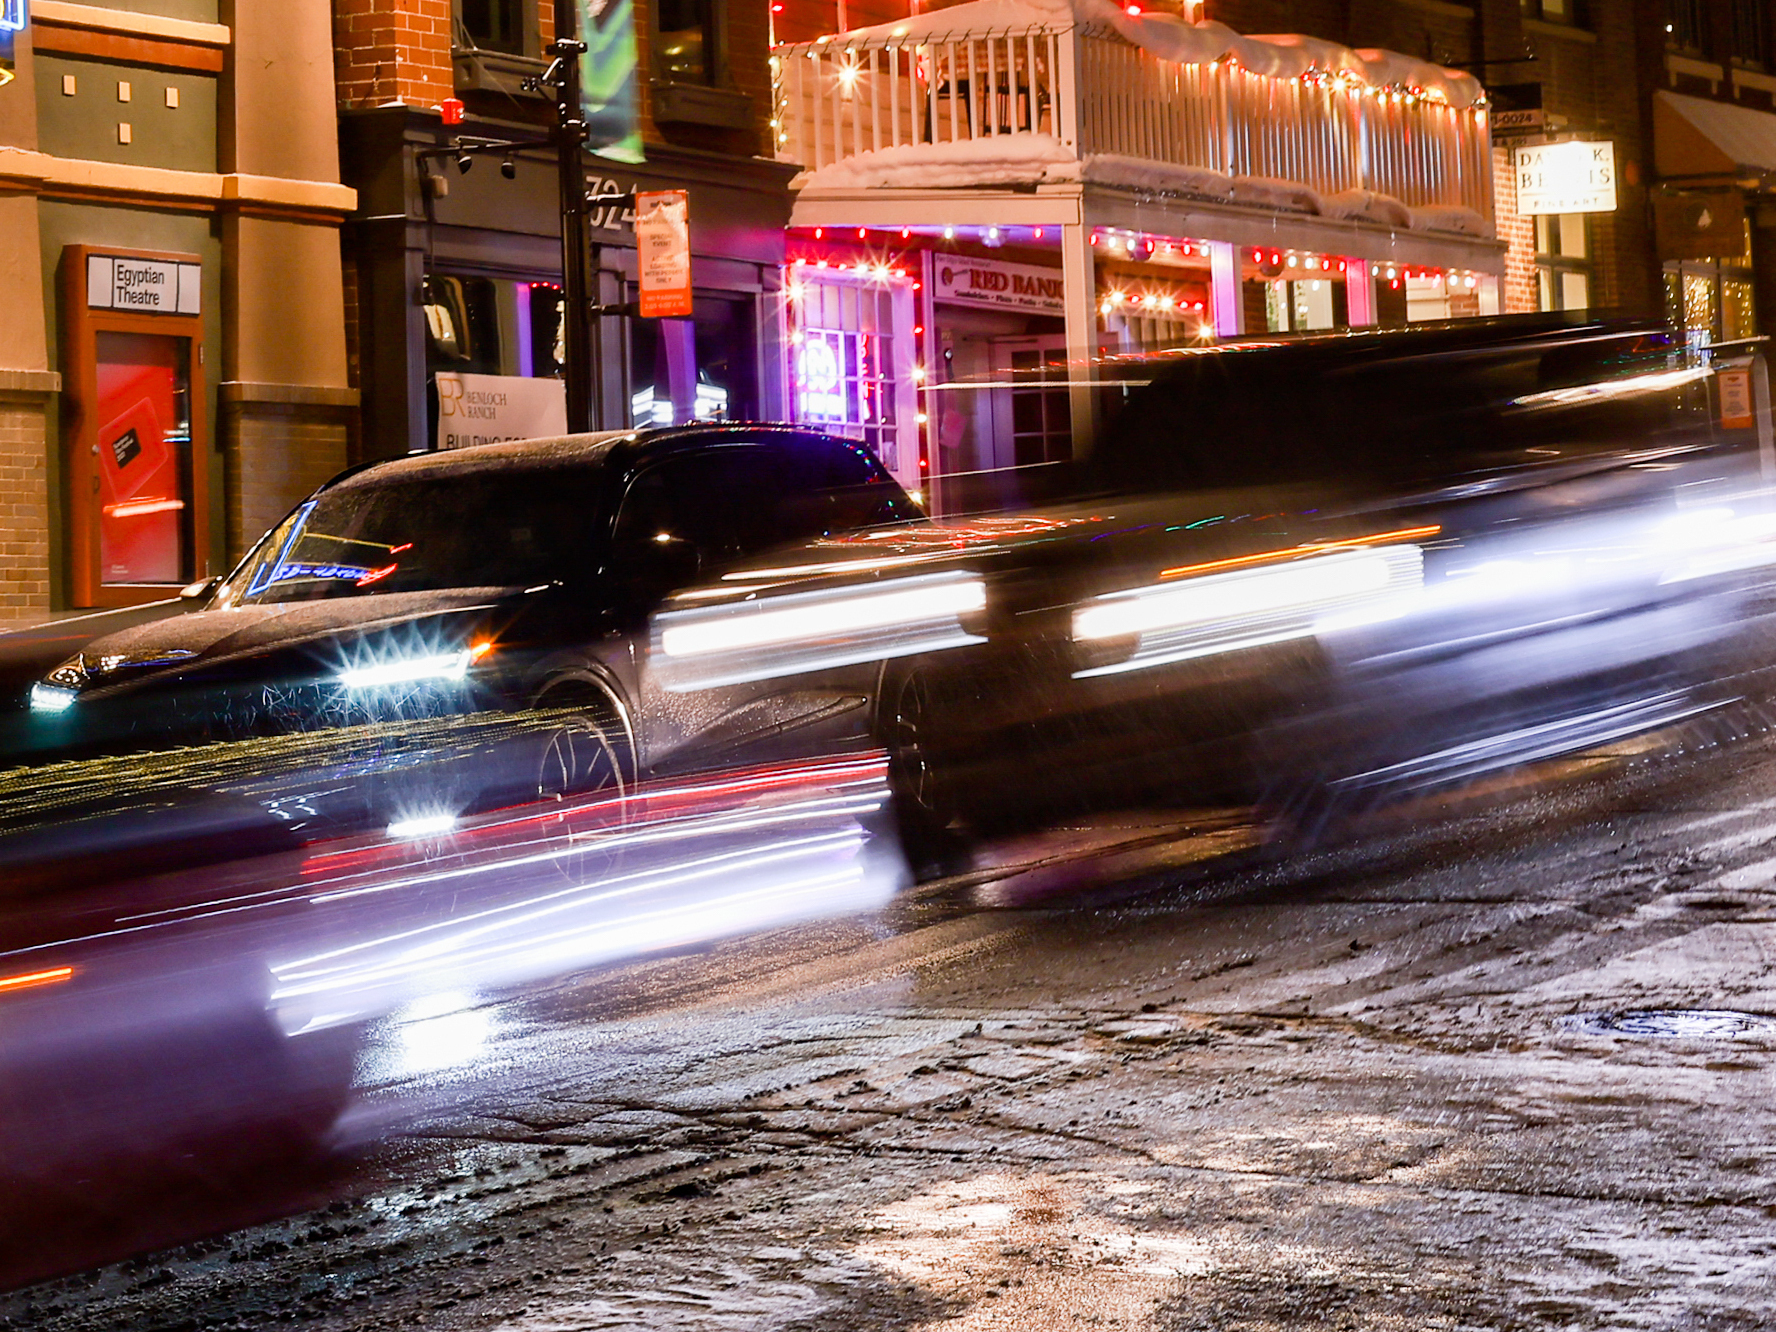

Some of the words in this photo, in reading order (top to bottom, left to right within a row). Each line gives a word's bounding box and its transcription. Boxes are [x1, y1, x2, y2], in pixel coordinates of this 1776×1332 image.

[1522, 167, 1610, 188] BEIS
[117, 264, 164, 286] Egyptian
[969, 268, 1009, 291] RED
[116, 286, 160, 305] Theatre
[467, 391, 507, 406] BENLOCH
[468, 407, 496, 419] RANCH
